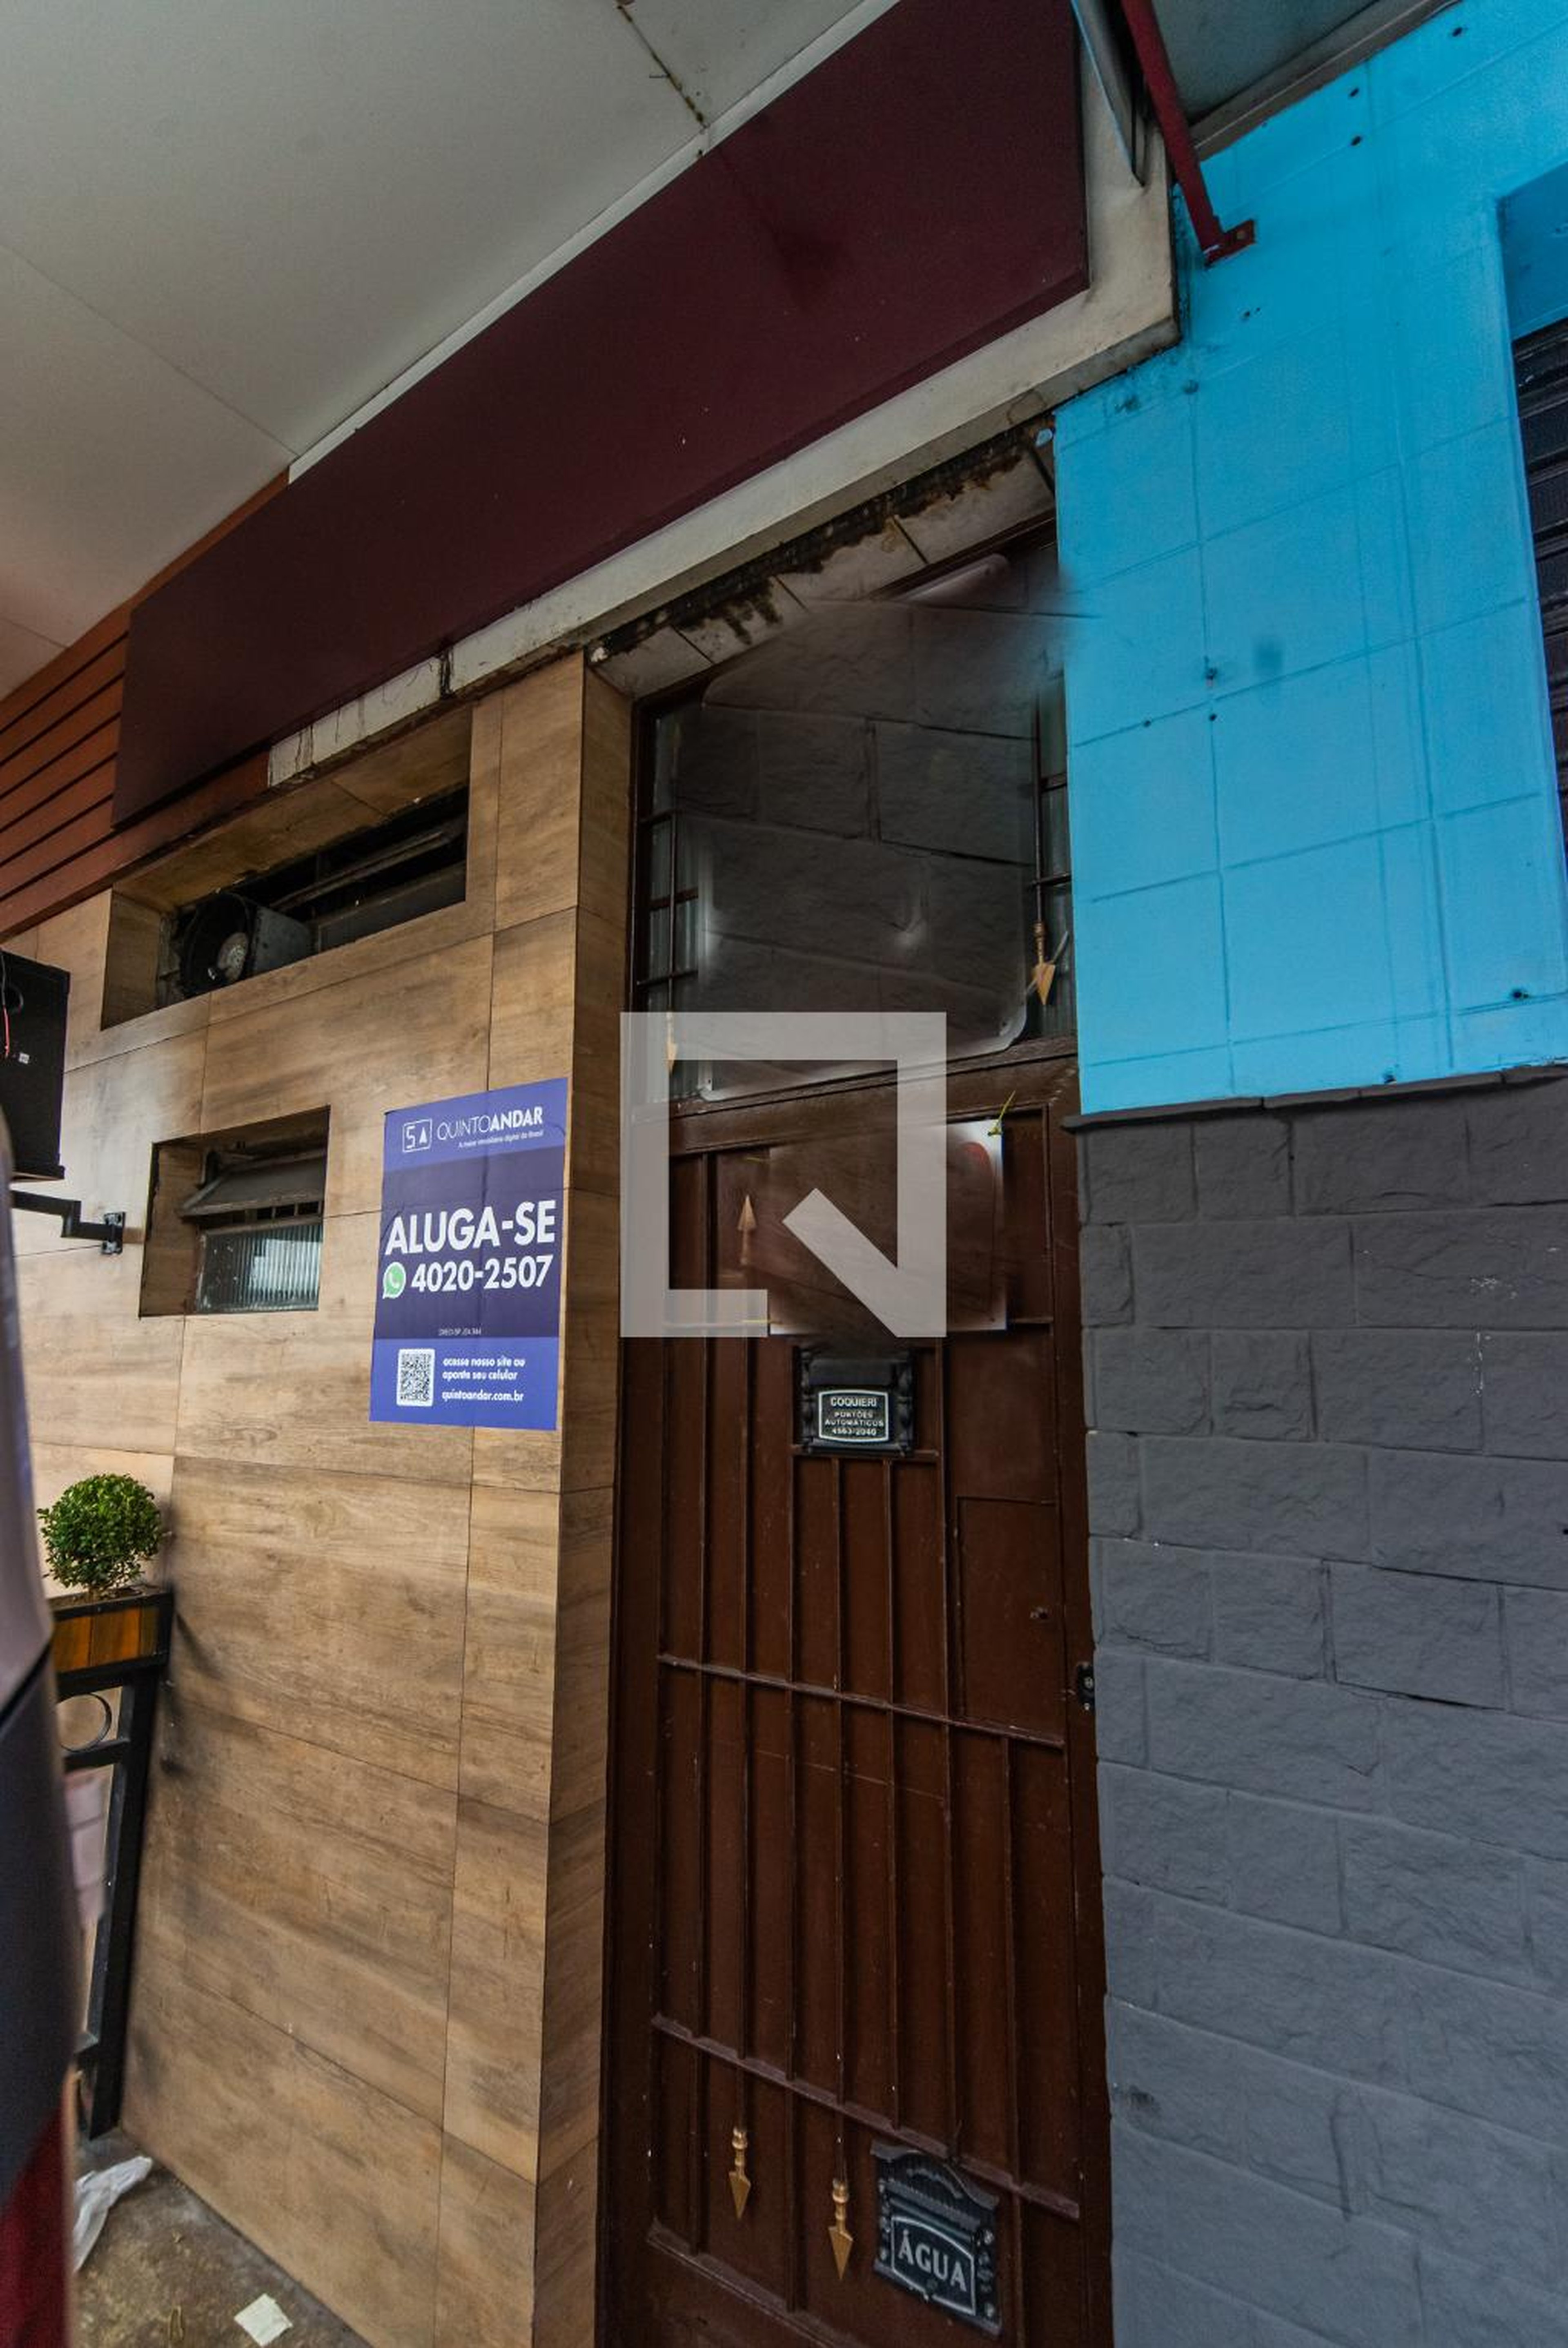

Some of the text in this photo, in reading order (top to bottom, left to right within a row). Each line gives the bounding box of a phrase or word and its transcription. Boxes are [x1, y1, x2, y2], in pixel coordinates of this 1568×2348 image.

[437, 1106, 543, 1140] QUINTOANDAR
[385, 1200, 556, 1255] ALUGA-SE
[411, 1254, 554, 1292] 4020-2507
[442, 1369, 470, 1382] aponte
[488, 1369, 518, 1380] celular
[471, 1358, 495, 1367] nosso
[497, 1355, 512, 1367] site
[513, 1359, 526, 1367] ou
[441, 1388, 524, 1402] quintoandar.com.br
[898, 2229, 967, 2292] ÁGUA
